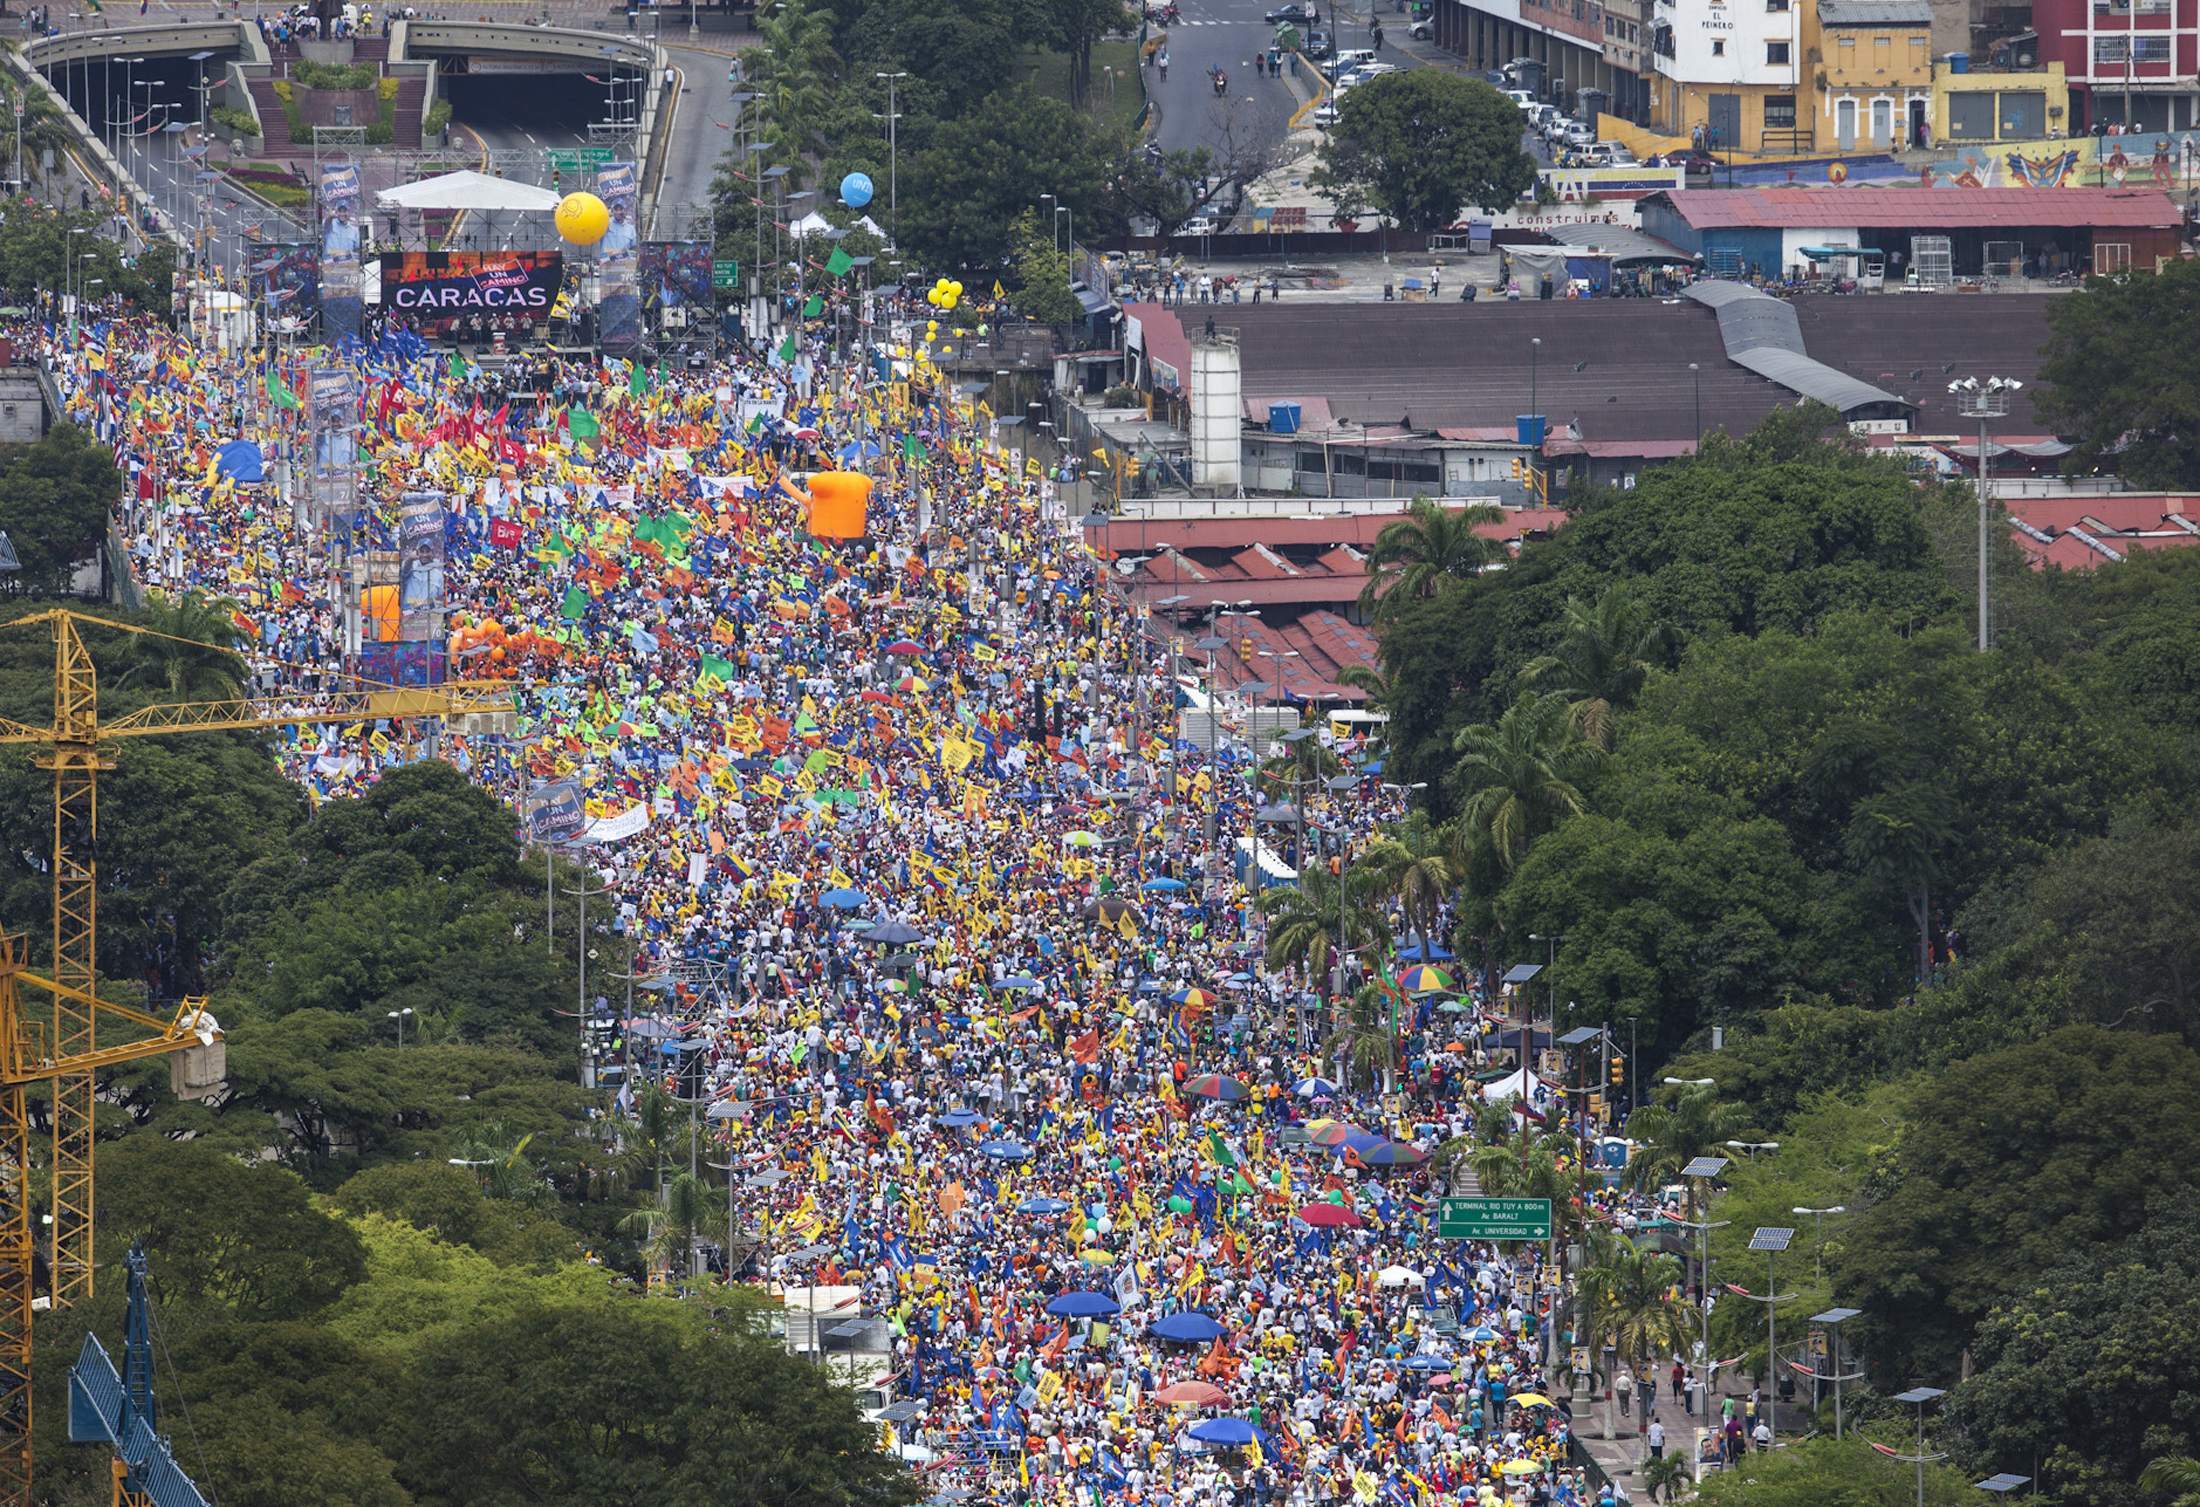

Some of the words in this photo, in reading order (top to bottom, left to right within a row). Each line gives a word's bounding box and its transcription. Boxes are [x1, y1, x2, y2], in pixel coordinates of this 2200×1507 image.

[1713, 12, 1721, 20] EL
[482, 263, 506, 271] HAY
[480, 274, 525, 288] CAMINO
[396, 287, 547, 307] CARACAS
[415, 514, 430, 523] UN
[408, 519, 443, 535] CAMINO
[1455, 1202, 1487, 1210] TERMINAL
[1489, 1202, 1500, 1210] RIO
[1503, 1202, 1516, 1210] TUY
[1493, 1212, 1519, 1220] BARALT
[1484, 1227, 1527, 1235] UNIVERSIDAD
